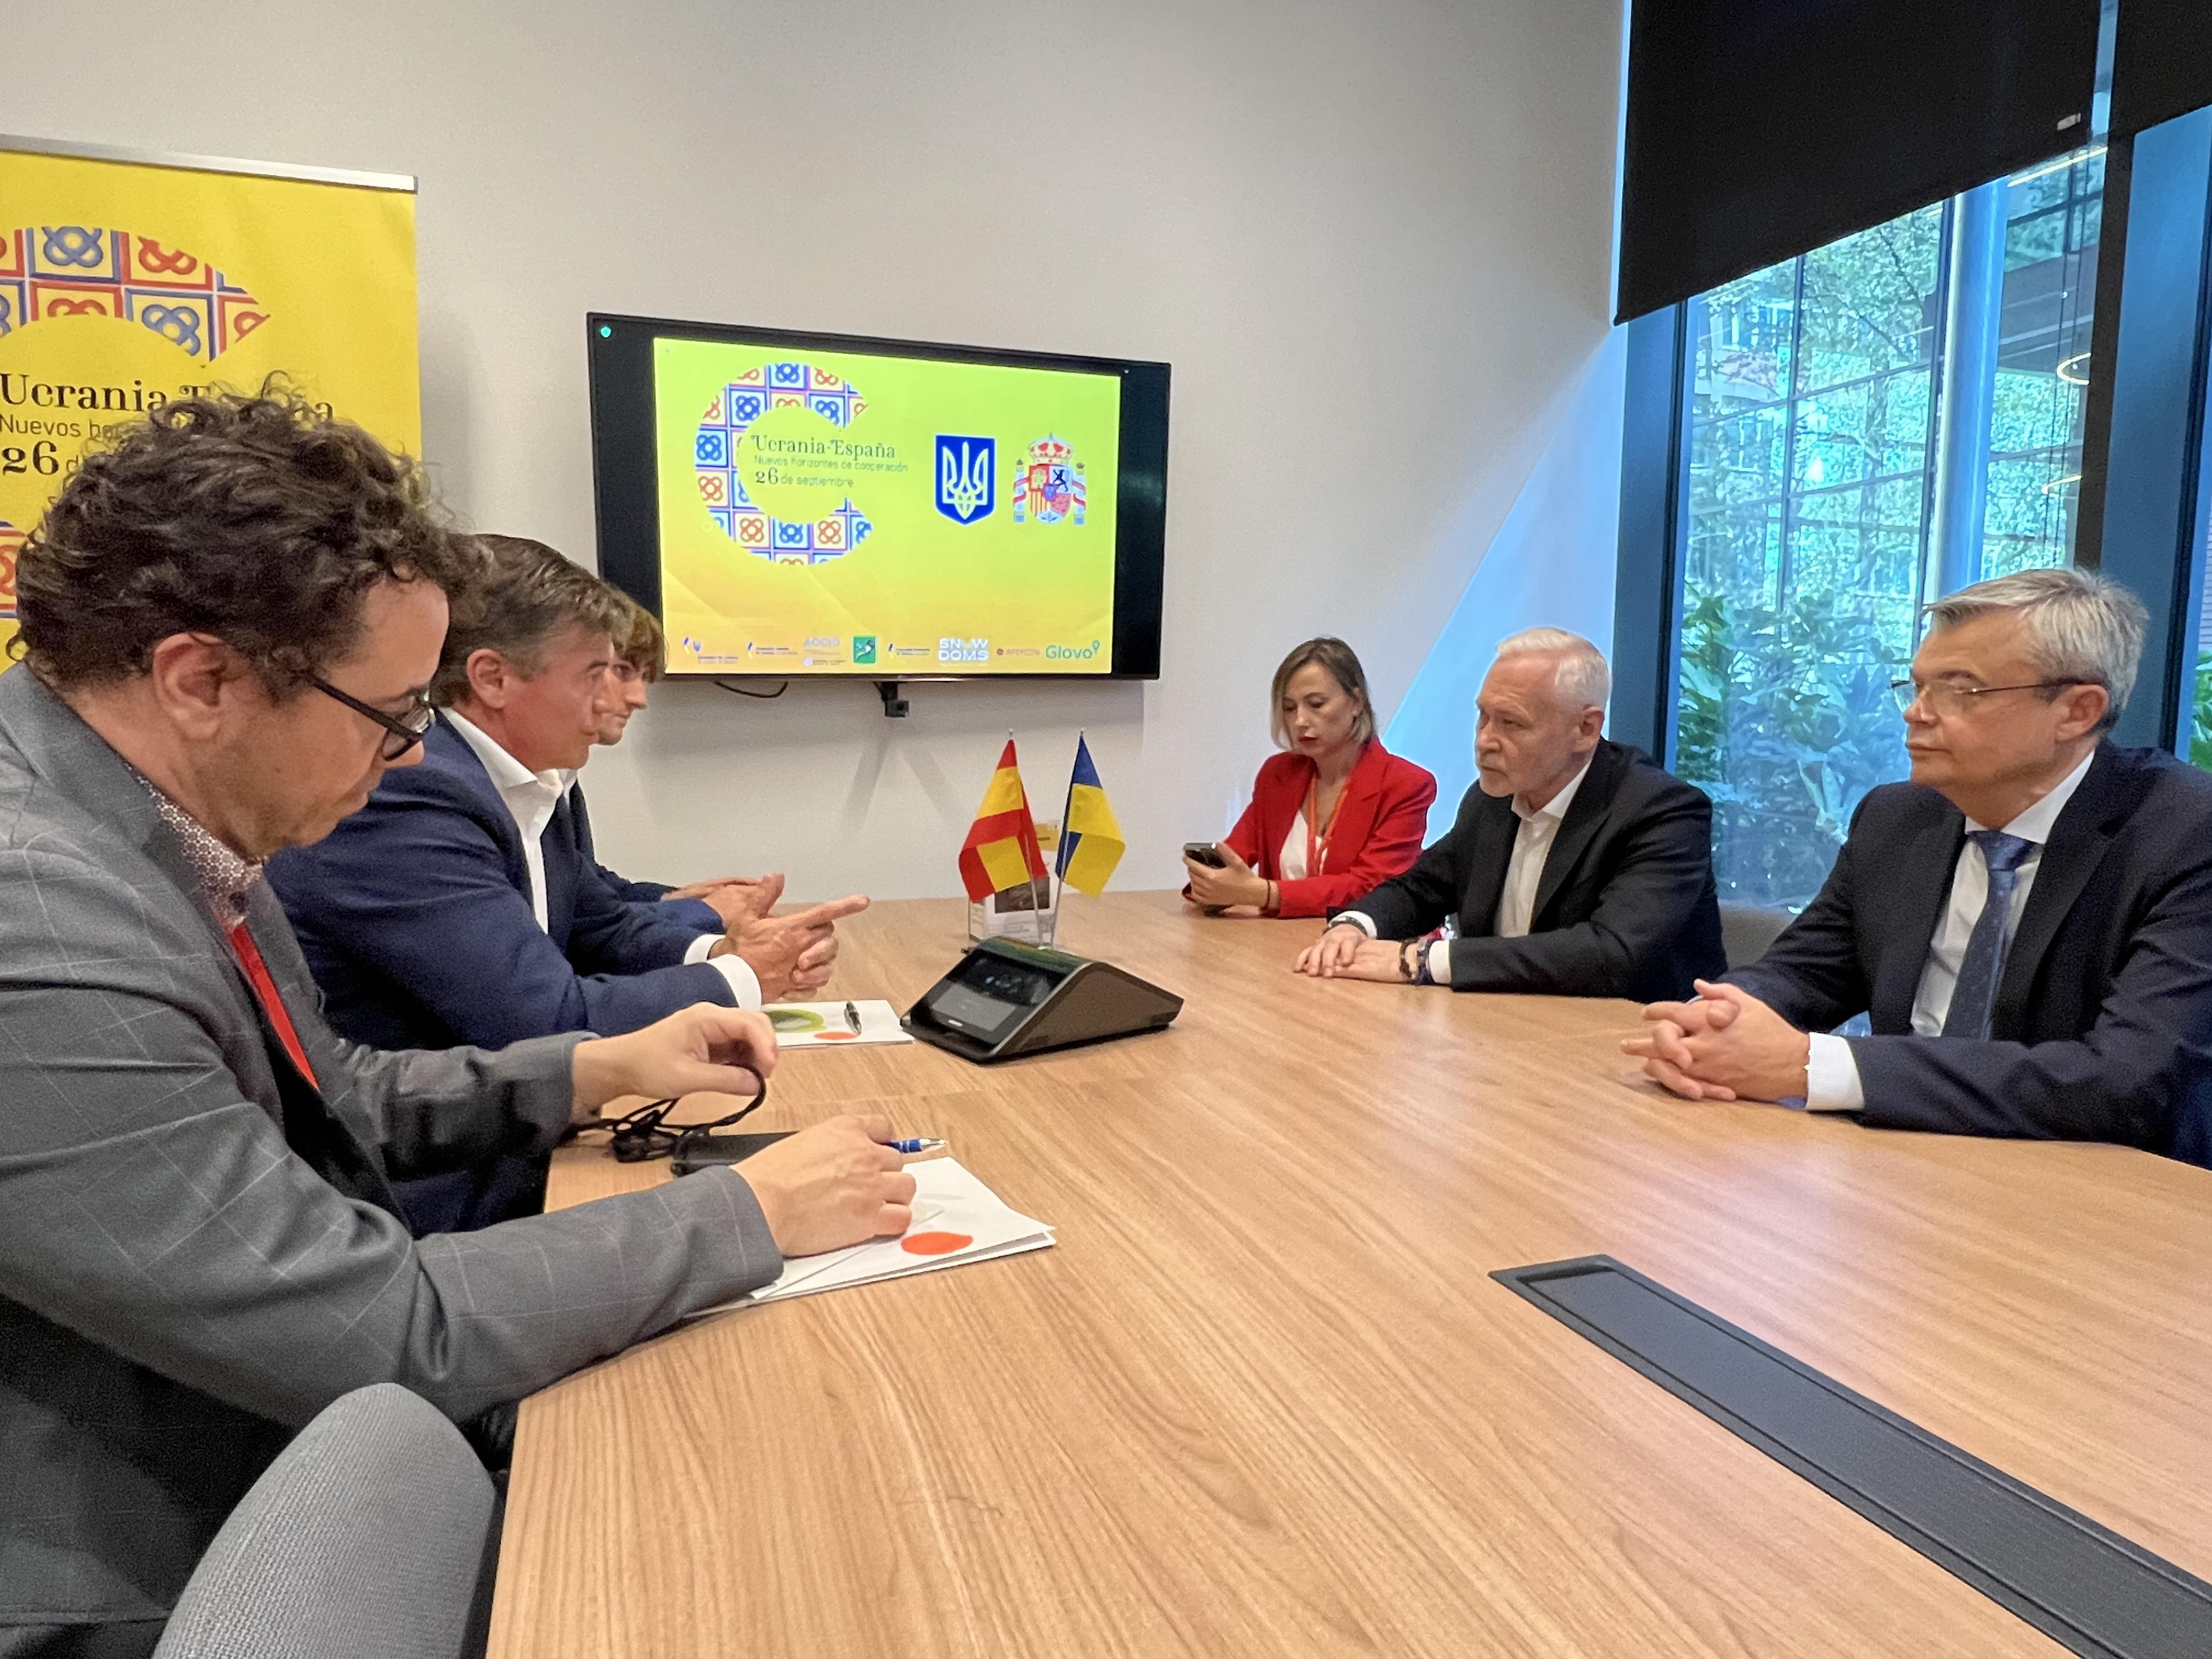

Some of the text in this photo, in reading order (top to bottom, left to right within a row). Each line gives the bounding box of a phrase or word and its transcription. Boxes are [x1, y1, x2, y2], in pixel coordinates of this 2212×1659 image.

[0, 414, 81, 437] Nuevos
[2, 441, 59, 476] 26
[754, 454, 788, 466] Nuevos
[791, 457, 838, 470] horizontes
[755, 467, 778, 485] 26
[781, 474, 793, 485] de
[938, 649, 988, 661] DOMS
[1045, 644, 1093, 659] Glovo
